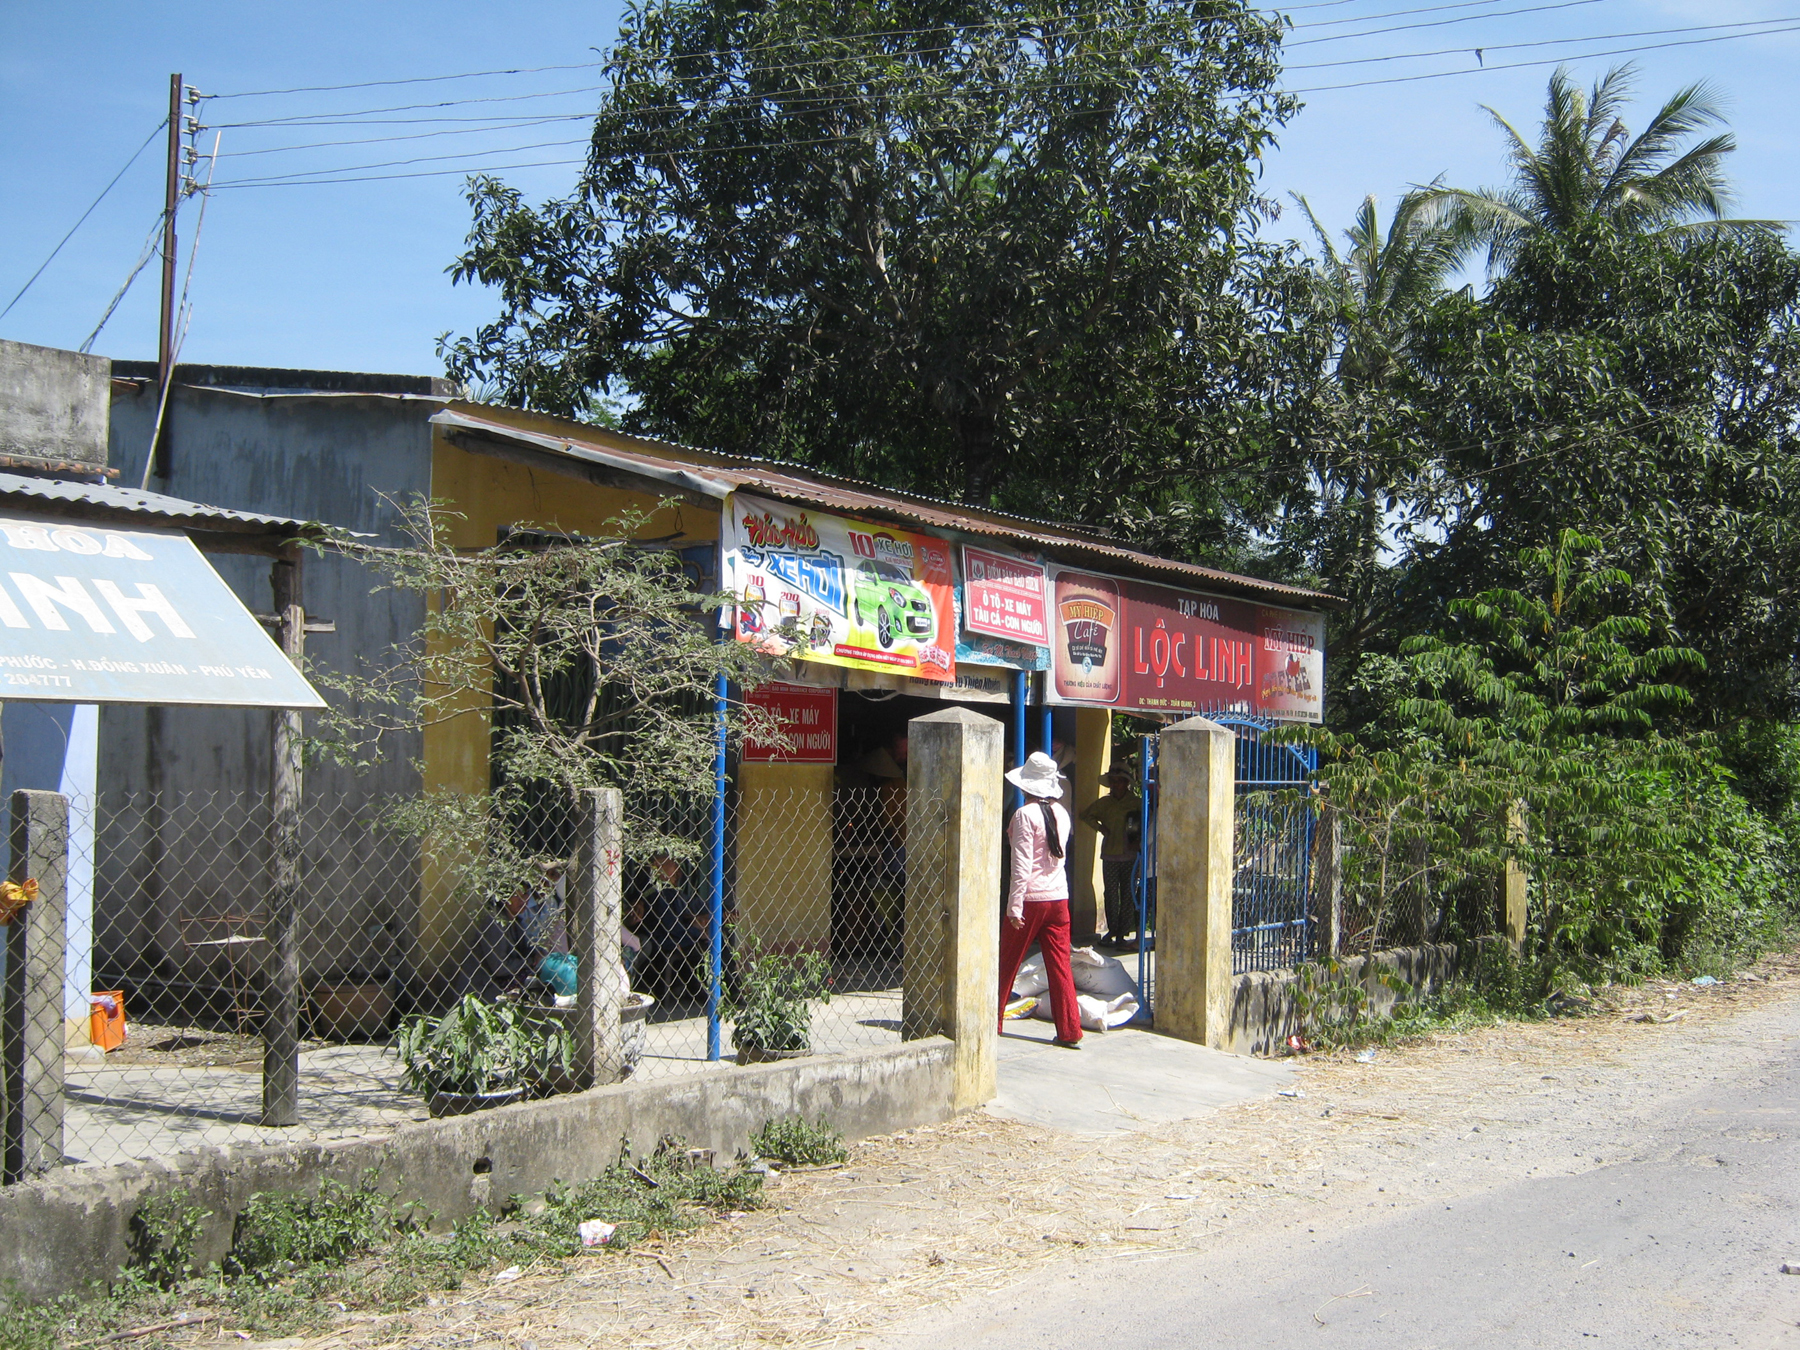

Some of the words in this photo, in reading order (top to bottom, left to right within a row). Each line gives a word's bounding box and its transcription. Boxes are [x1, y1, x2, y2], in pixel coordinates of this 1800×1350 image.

[847, 531, 877, 559] 10
[877, 538, 894, 553] XE
[894, 541, 914, 558] HƠI
[769, 552, 797, 584] XE
[781, 591, 800, 602] 200
[983, 589, 989, 607] Ô
[990, 592, 1001, 609] TÔ
[1004, 598, 1015, 613] XE
[1015, 600, 1032, 617] MÁY
[973, 605, 990, 624] TÀU
[990, 610, 1002, 627] CÁ
[1004, 615, 1021, 631] CON
[1178, 598, 1197, 619] TẠP
[1200, 600, 1220, 621] HÓA
[1134, 618, 1187, 688] LỘC
[1195, 634, 1253, 690] LINH
[4, 673, 72, 687] 204777
[139, 660, 189, 676] XUÂN
[235, 665, 273, 680] YÊN
[789, 708, 800, 724] XE
[802, 705, 820, 725] MÁY
[806, 729, 831, 750] NGƯỜI
